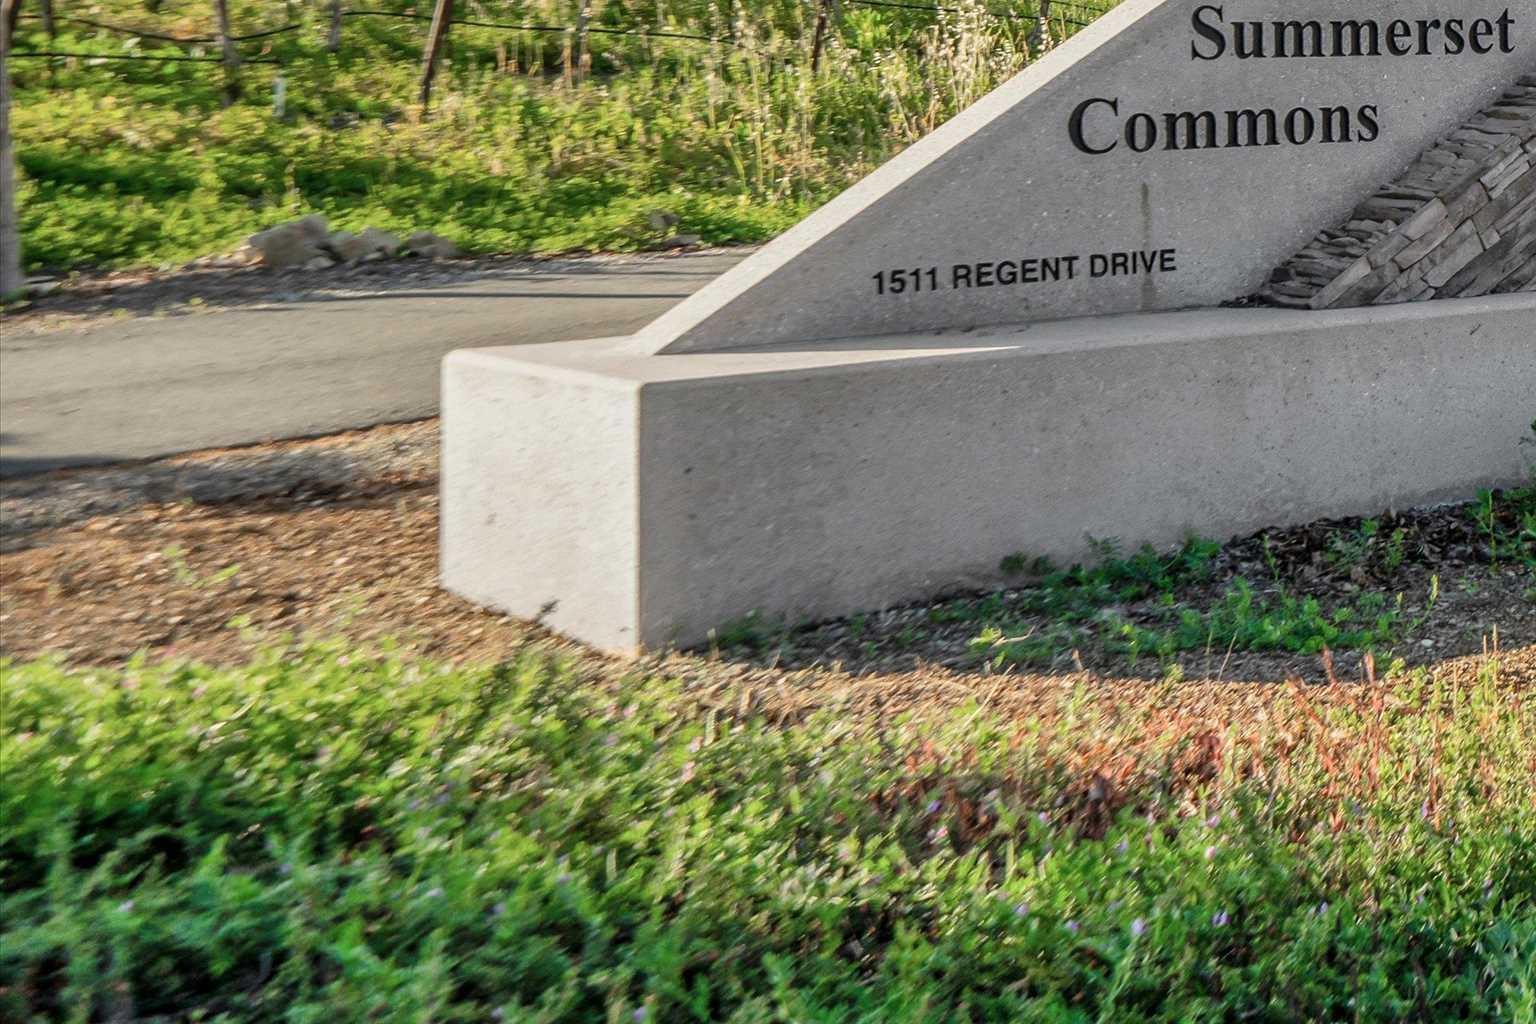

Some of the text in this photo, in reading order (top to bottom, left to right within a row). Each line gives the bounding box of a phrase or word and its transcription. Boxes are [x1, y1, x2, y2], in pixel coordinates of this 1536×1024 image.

[1190, 4, 1515, 61] Summerset
[1067, 96, 1379, 155] Commons
[872, 248, 1177, 295] 1511 REGENT DRIVE
